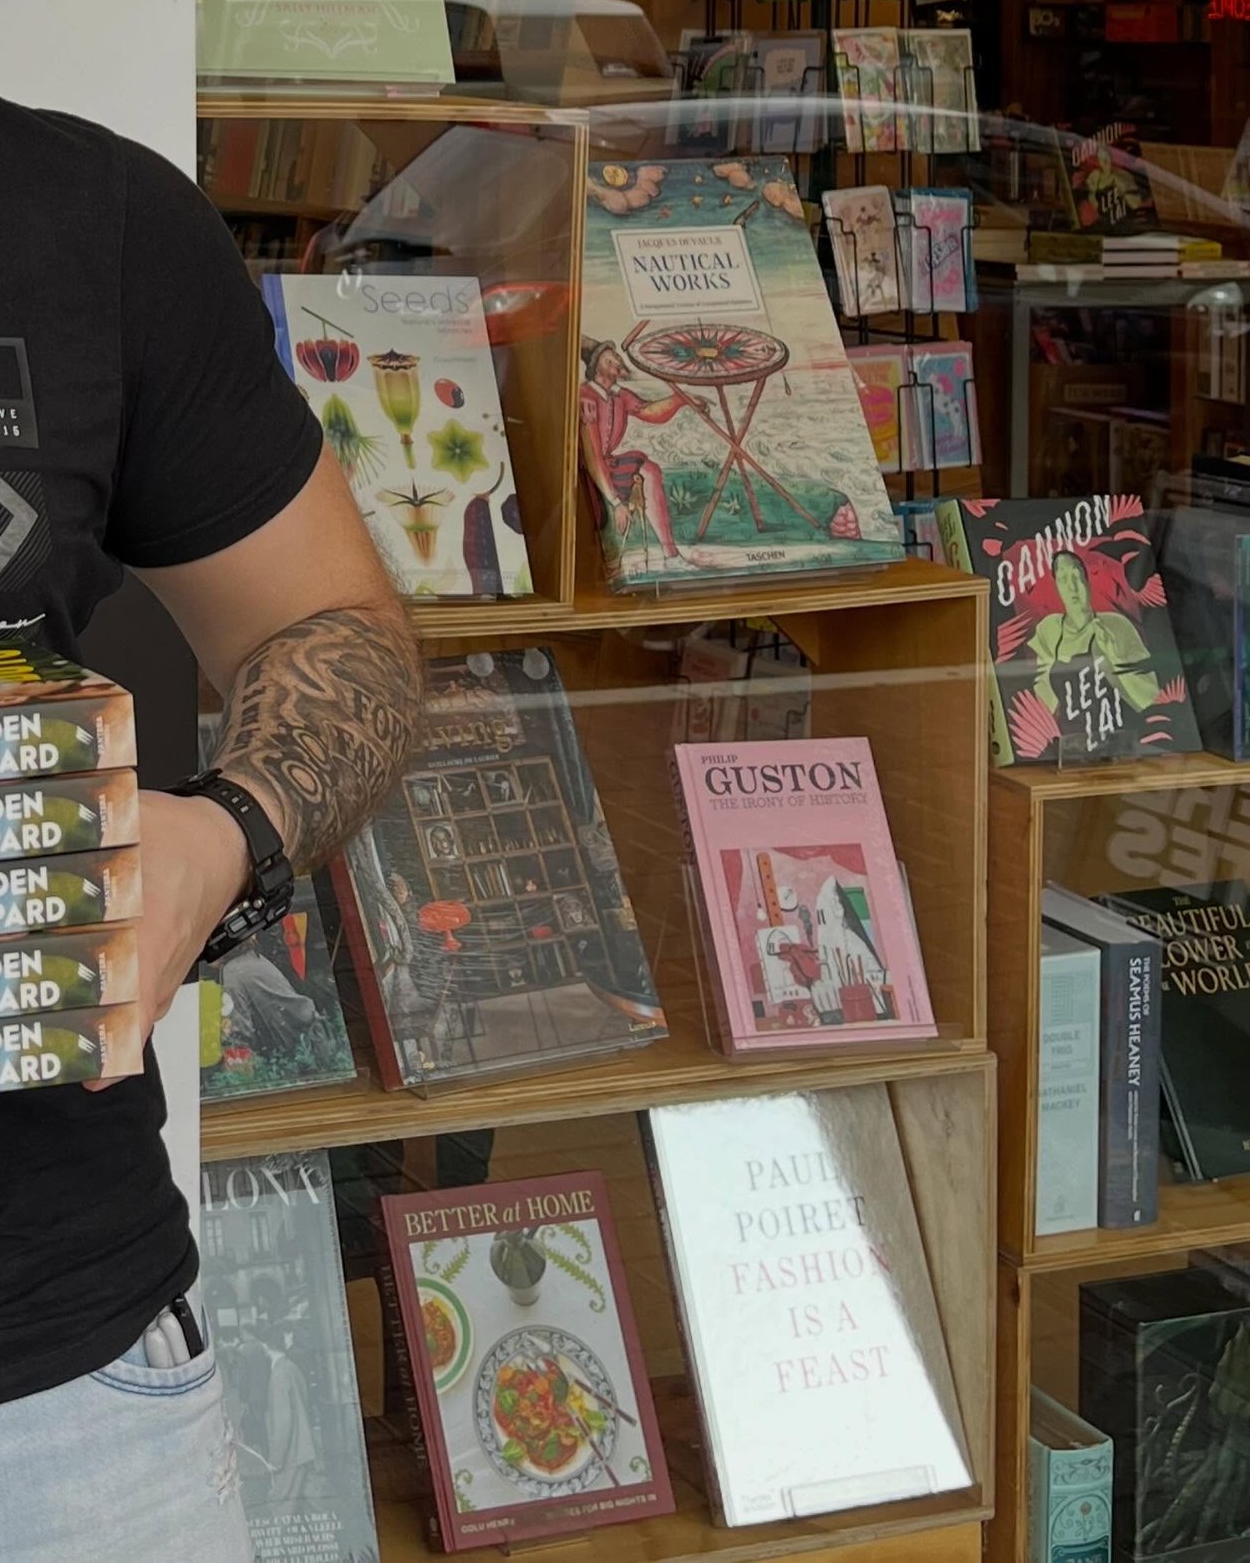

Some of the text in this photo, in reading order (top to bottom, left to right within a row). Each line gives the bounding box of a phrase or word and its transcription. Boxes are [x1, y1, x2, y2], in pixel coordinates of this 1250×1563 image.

[632, 252, 740, 274] NAUTICAL
[650, 272, 732, 293] WORKS
[362, 284, 469, 314] Seeds
[746, 550, 786, 561] TASCHEN
[996, 495, 1111, 606] CANNON
[1065, 656, 1104, 720] LEE
[1085, 688, 1123, 751] LAI
[701, 755, 738, 764] PHILIP
[705, 762, 862, 795] GUSTON
[709, 792, 869, 810] THE IRONY OF HISTORY
[1128, 958, 1141, 1021] SEAMUS
[1171, 963, 1250, 996] WORL
[1128, 1024, 1141, 1086] HEANEY
[744, 1151, 839, 1192] PAUL
[404, 1190, 595, 1236] BETTER at HOME
[736, 1195, 866, 1243] POIRET
[729, 1241, 893, 1295] FASHION
[788, 1300, 861, 1339] IS A
[774, 1345, 892, 1394] FEAST
